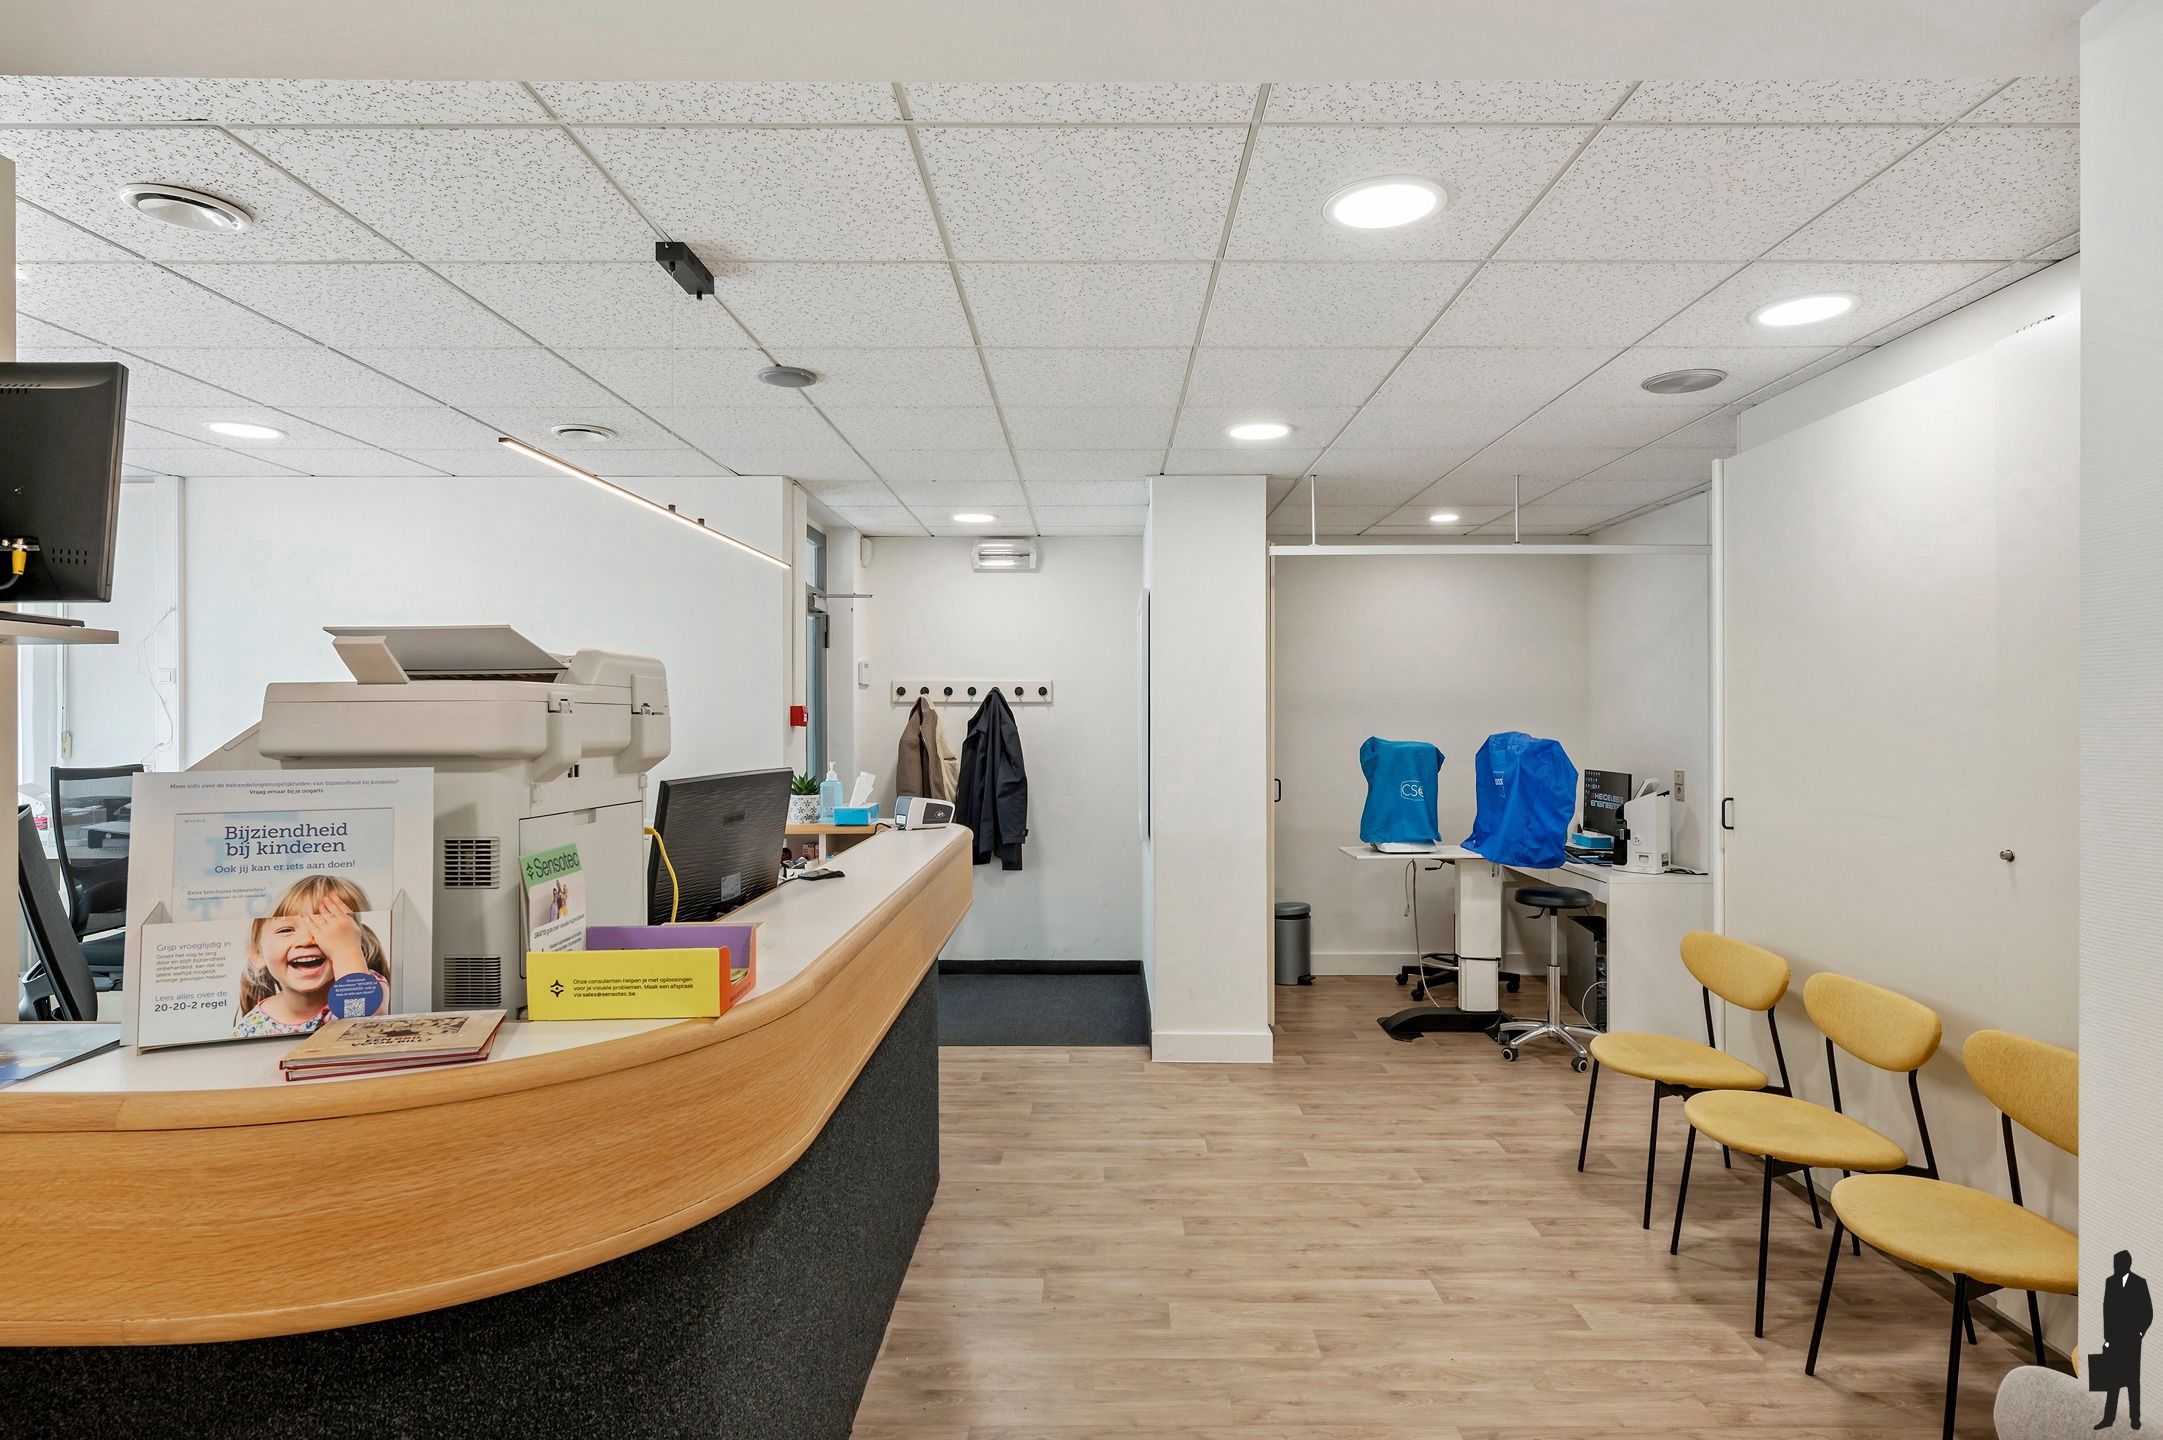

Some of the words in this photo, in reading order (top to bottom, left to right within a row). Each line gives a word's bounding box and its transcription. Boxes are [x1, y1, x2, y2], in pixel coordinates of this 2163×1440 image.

[224, 823, 348, 842] Bijziendheid
[226, 842, 250, 859] bij
[257, 841, 345, 855] kinderen
[214, 865, 236, 874] Ook
[239, 865, 249, 874] jij
[251, 864, 271, 872] kan
[273, 863, 284, 871] er
[287, 862, 304, 871] iets
[306, 862, 325, 870] aan
[327, 860, 355, 868] doen!
[534, 852, 580, 878] Sensotec
[179, 942, 221, 950] vroegtijdig
[176, 992, 195, 1000] alles
[196, 991, 215, 999] over
[154, 1001, 198, 1012] 20-20-2
[200, 999, 227, 1009] regel
